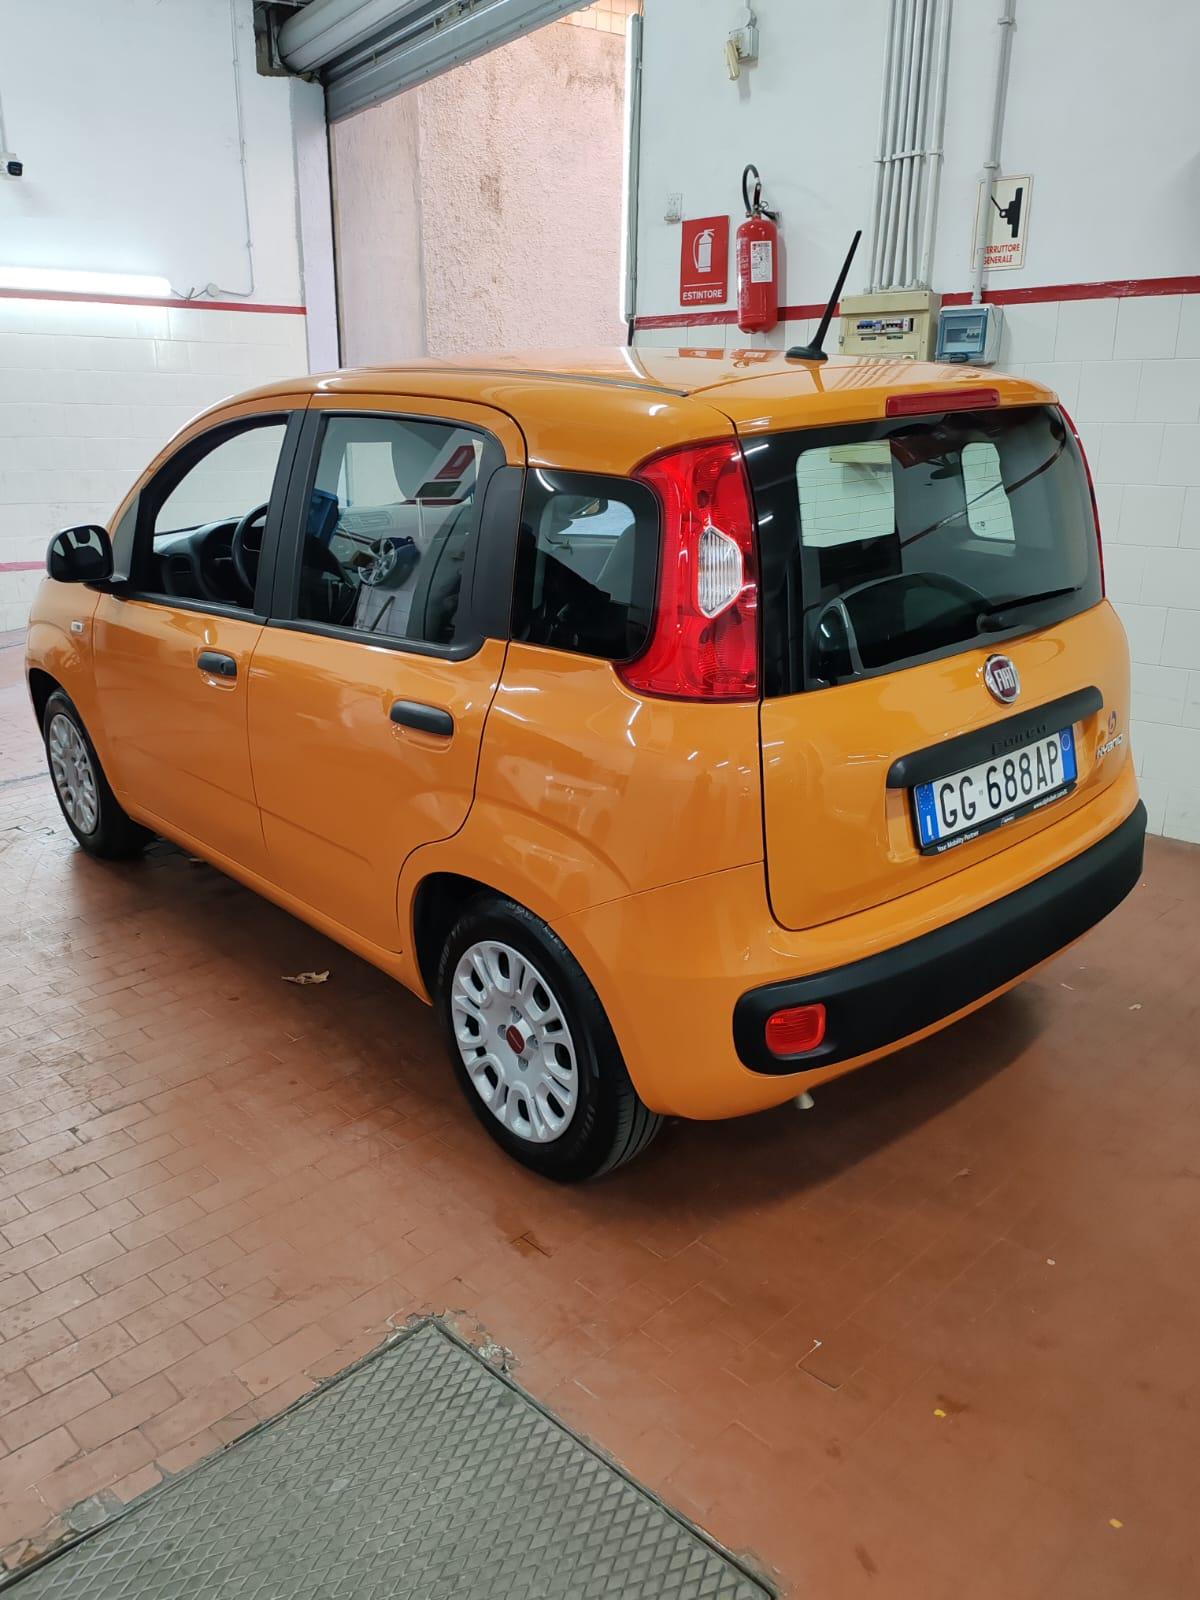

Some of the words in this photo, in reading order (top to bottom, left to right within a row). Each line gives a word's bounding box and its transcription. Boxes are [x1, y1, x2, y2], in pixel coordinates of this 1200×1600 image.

[682, 289, 723, 300] ESTINTORE
[993, 667, 1015, 692] FIAT
[939, 775, 976, 828] GG
[986, 740, 1058, 809] 688AP
